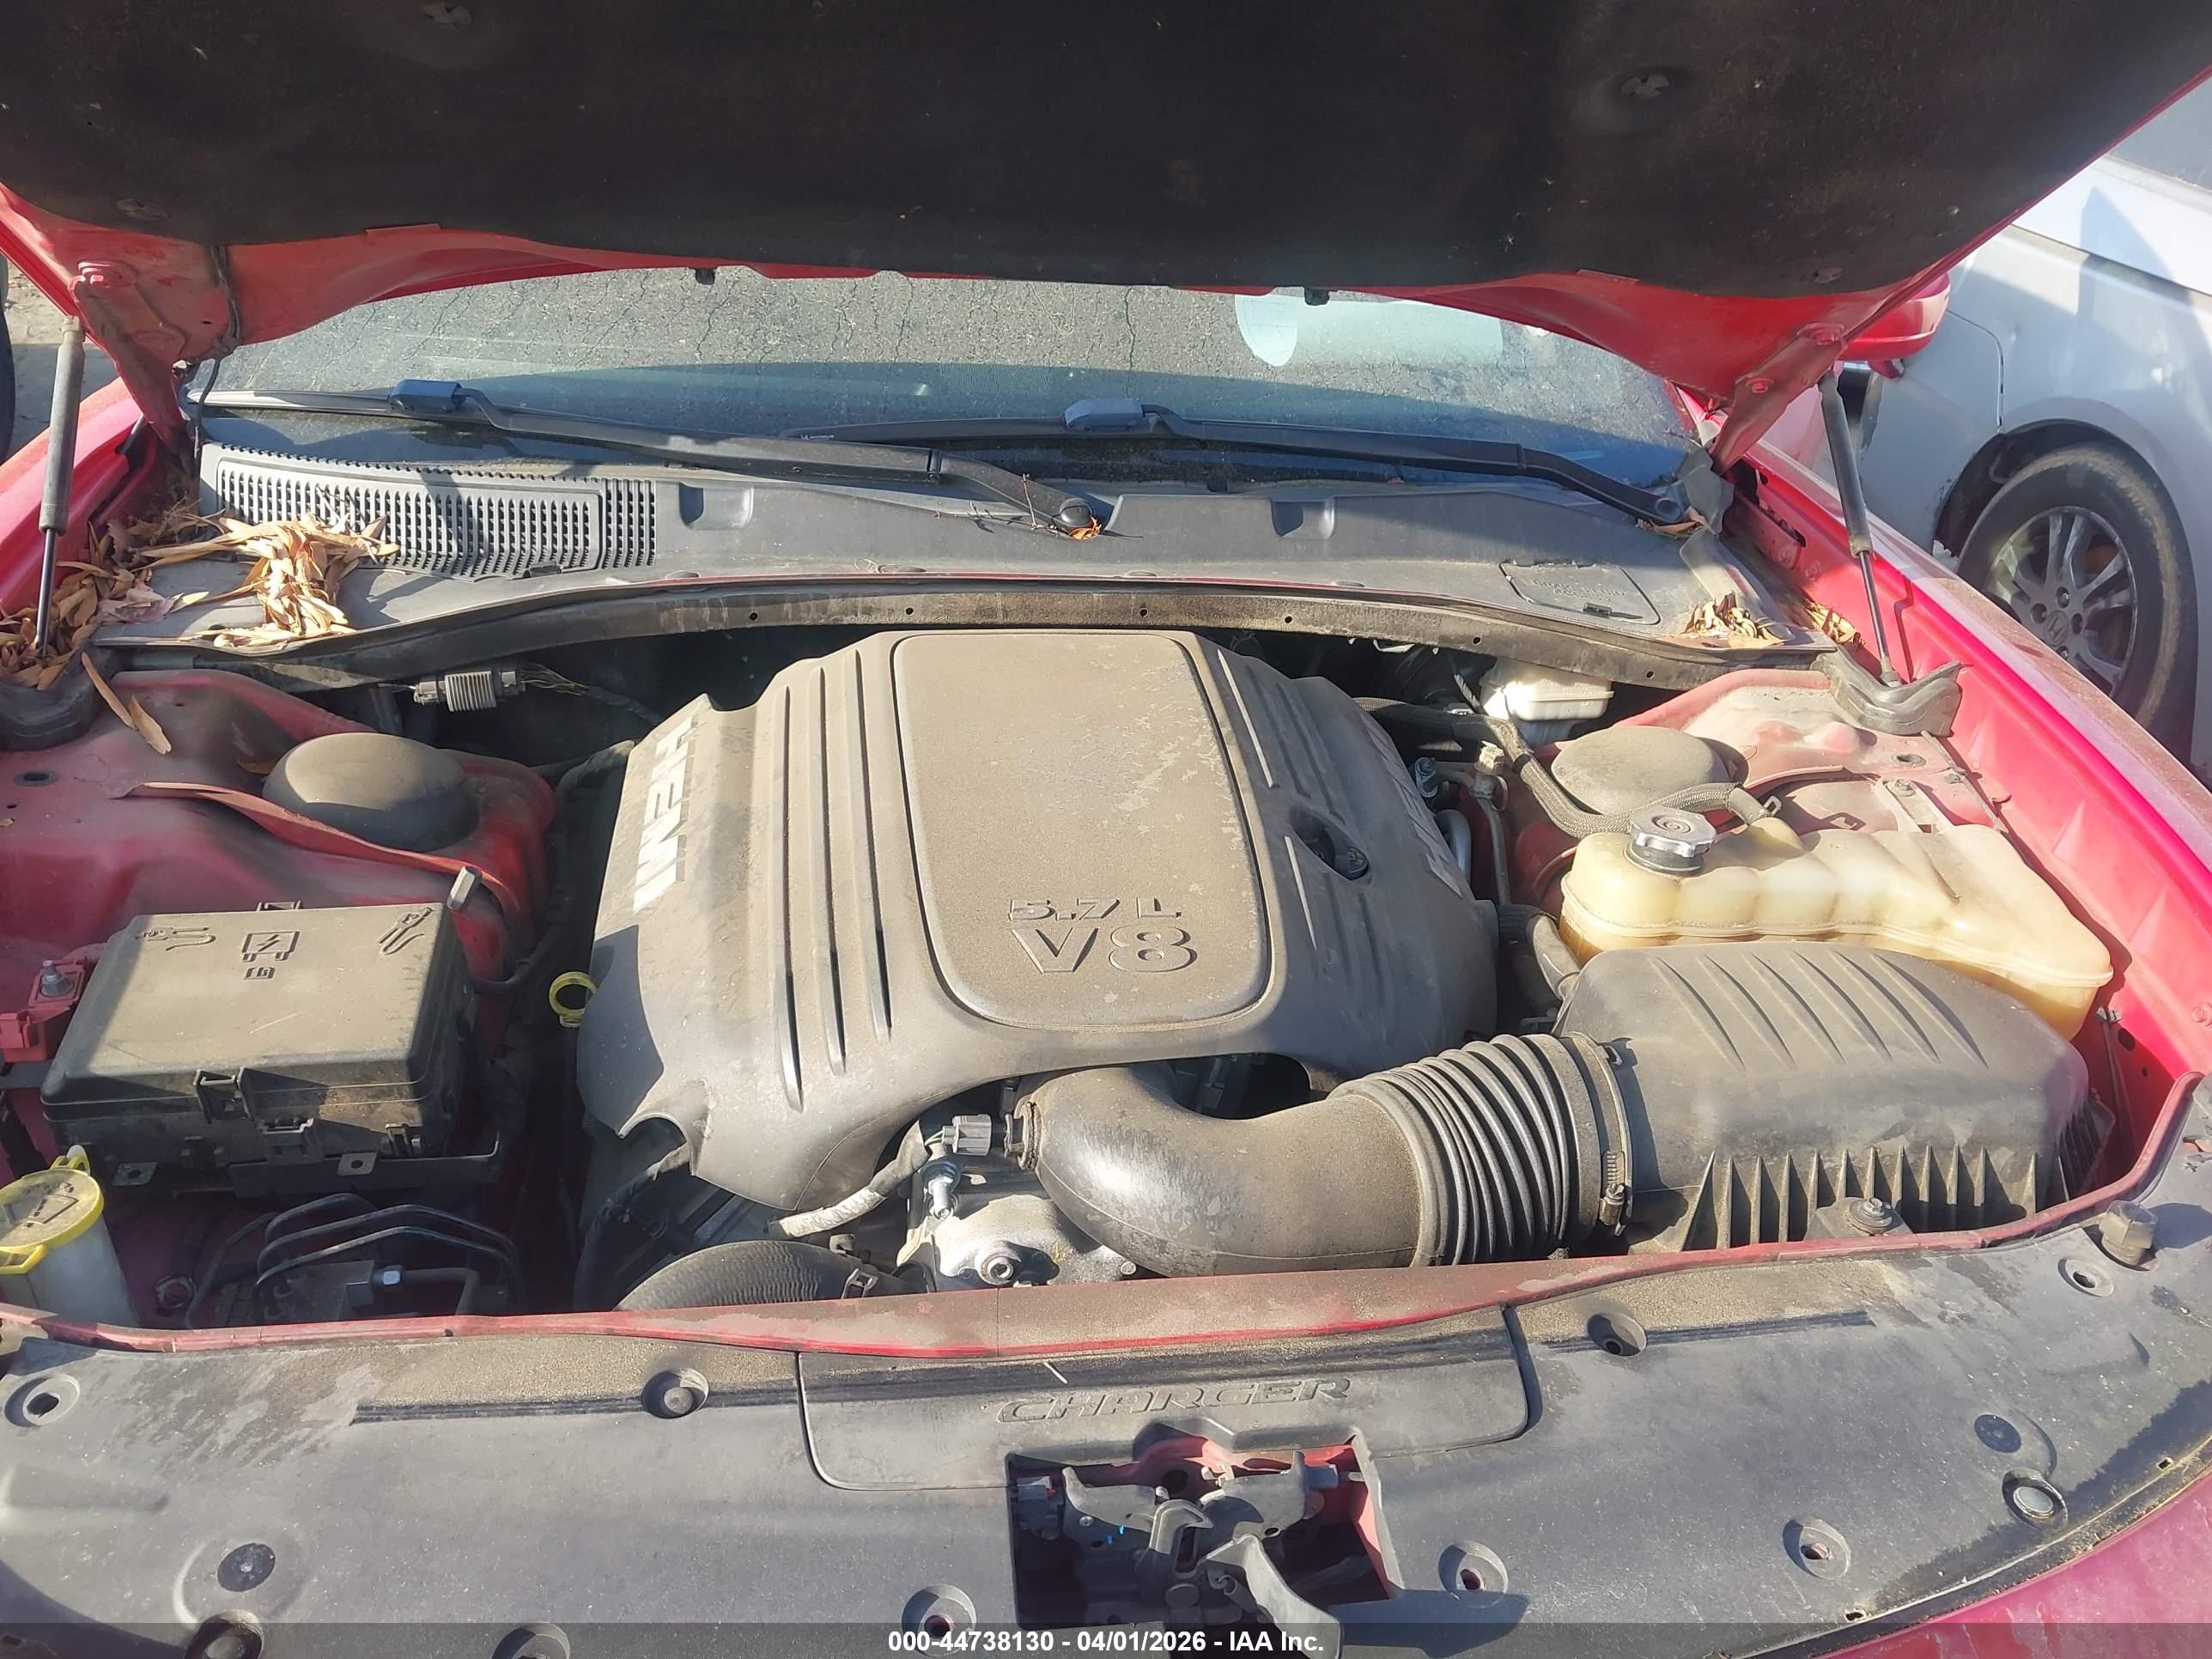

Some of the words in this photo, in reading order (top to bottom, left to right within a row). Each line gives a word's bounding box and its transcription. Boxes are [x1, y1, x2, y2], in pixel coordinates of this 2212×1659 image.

[633, 714, 694, 914] HEMI
[1010, 923, 1199, 975] V8
[996, 1376, 1352, 1424] CHARGER
